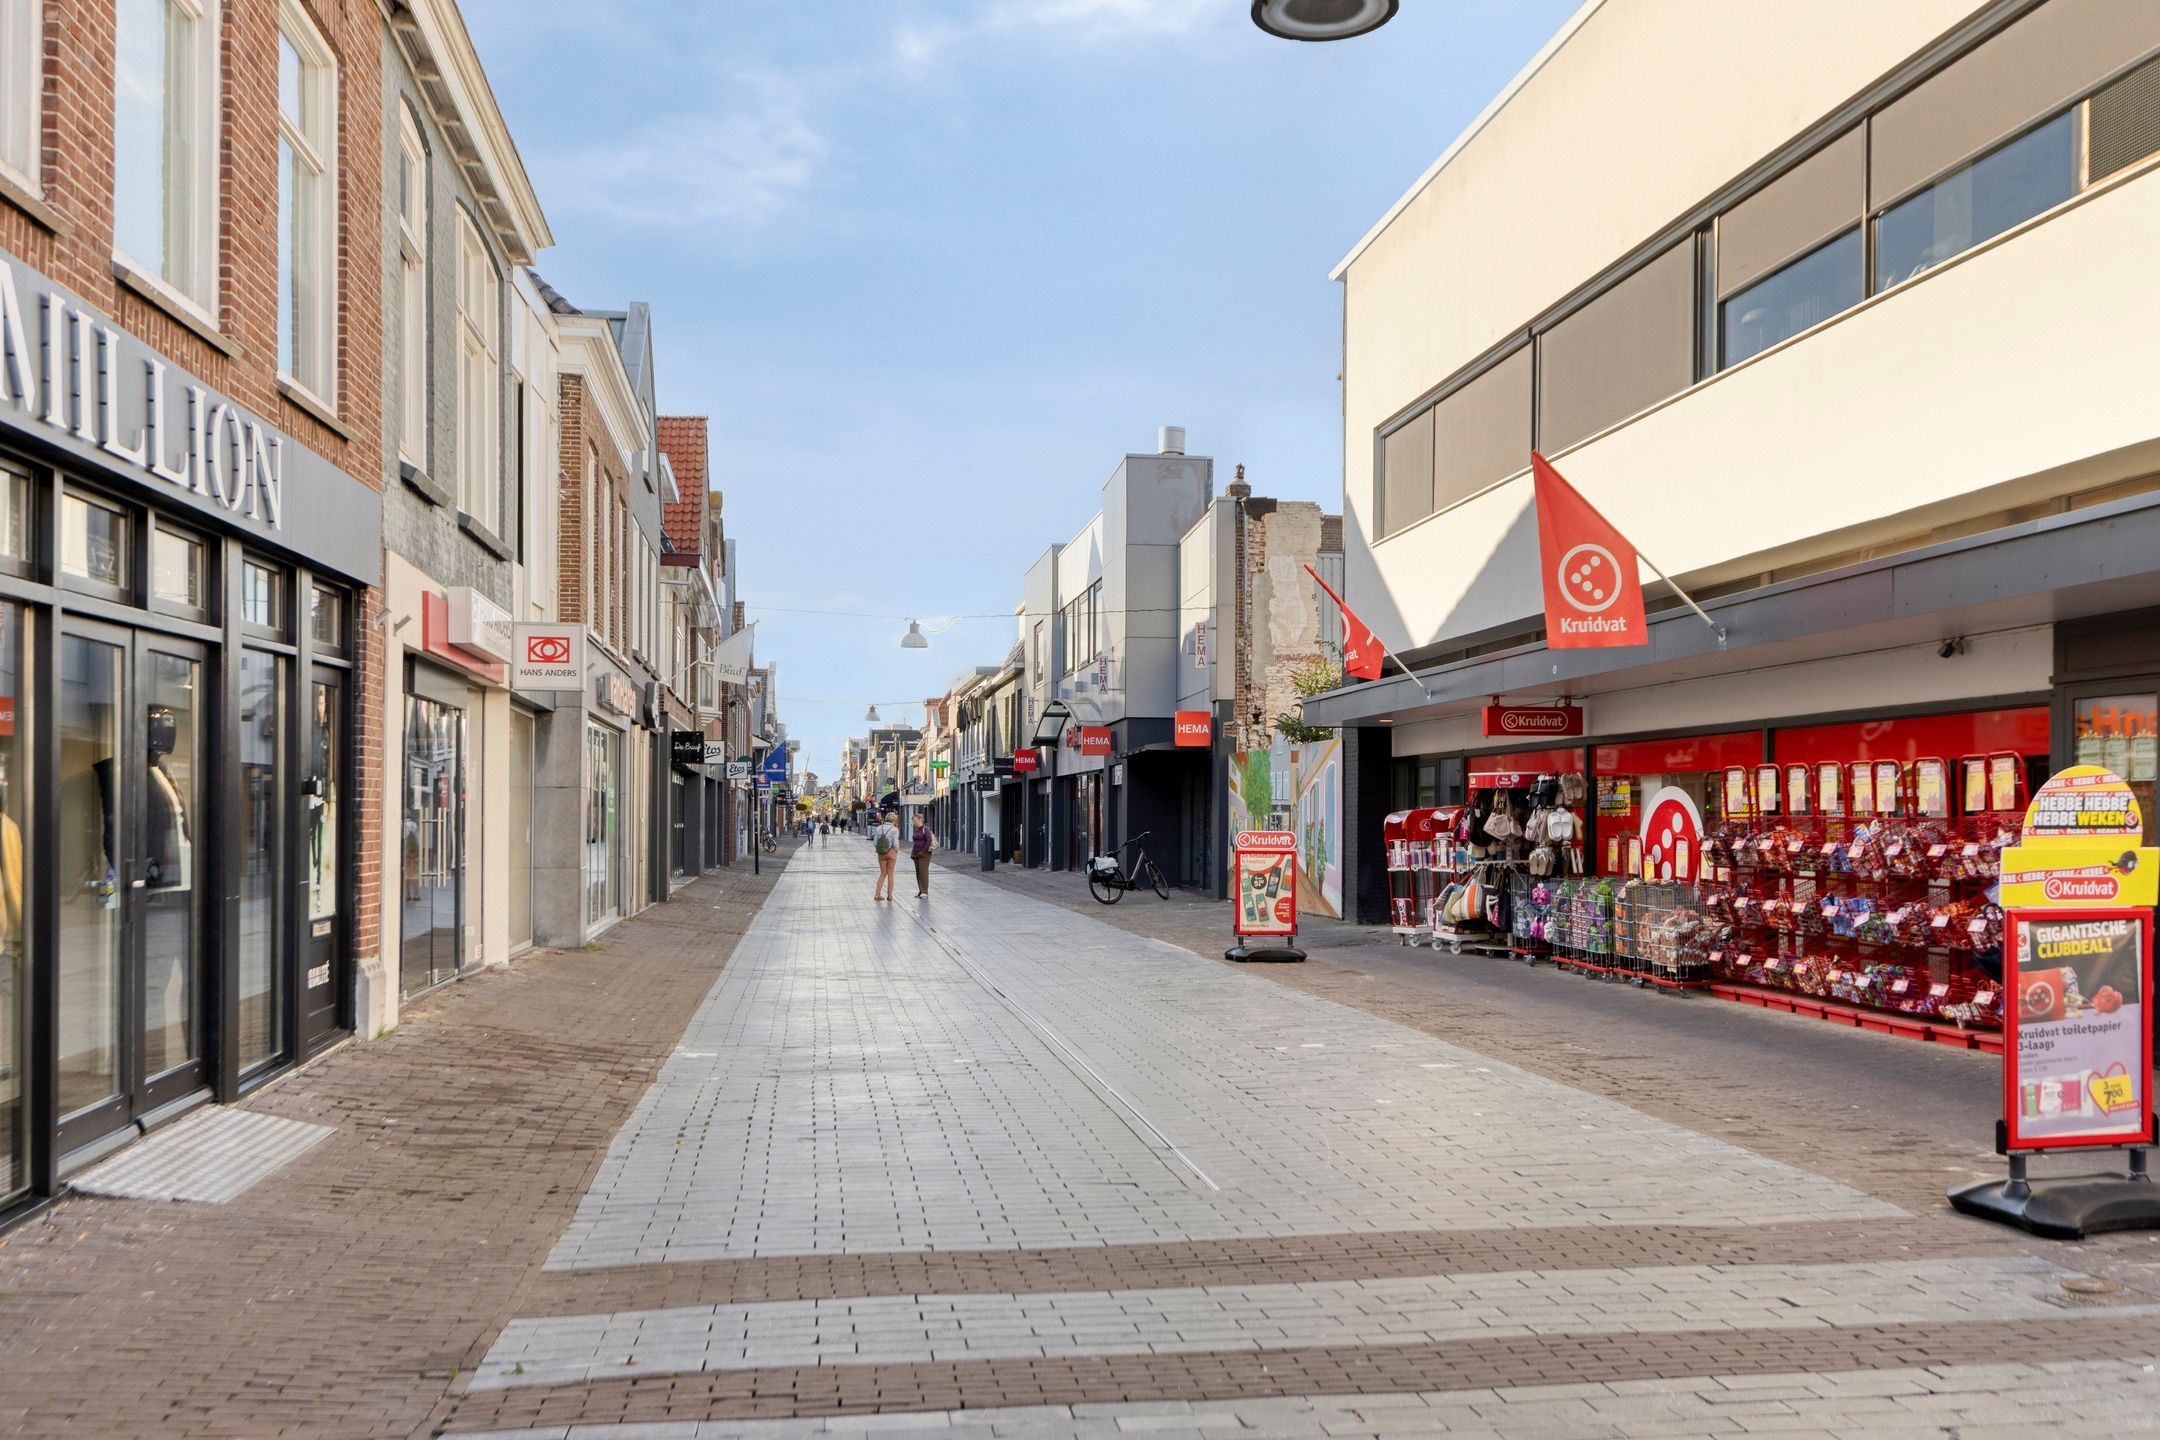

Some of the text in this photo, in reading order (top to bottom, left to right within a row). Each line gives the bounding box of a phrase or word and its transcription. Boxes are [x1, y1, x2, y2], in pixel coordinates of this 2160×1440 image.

[1561, 617, 1626, 634] Kruidvat
[1197, 624, 1205, 667] HEMA
[545, 669, 577, 677] ANDERS
[1518, 715, 1563, 727] Kruidvat
[1177, 724, 1209, 733] HEMA
[1083, 737, 1110, 745] HEMA
[1015, 756, 1036, 764] HEMA
[2040, 796, 2129, 811] HEBBE HEBBE
[2033, 811, 2125, 826] HEBBE WEKEN
[1251, 835, 1291, 845] Kruidvat
[2063, 882, 2114, 895] Kruidvat
[2036, 920, 2127, 943] GIGANTISCHE
[2038, 938, 2112, 959] CLUBDEAL!
[2018, 1021, 2122, 1040] Kruidvat toiletpapier
[2018, 1040, 2055, 1051] 3-laags
